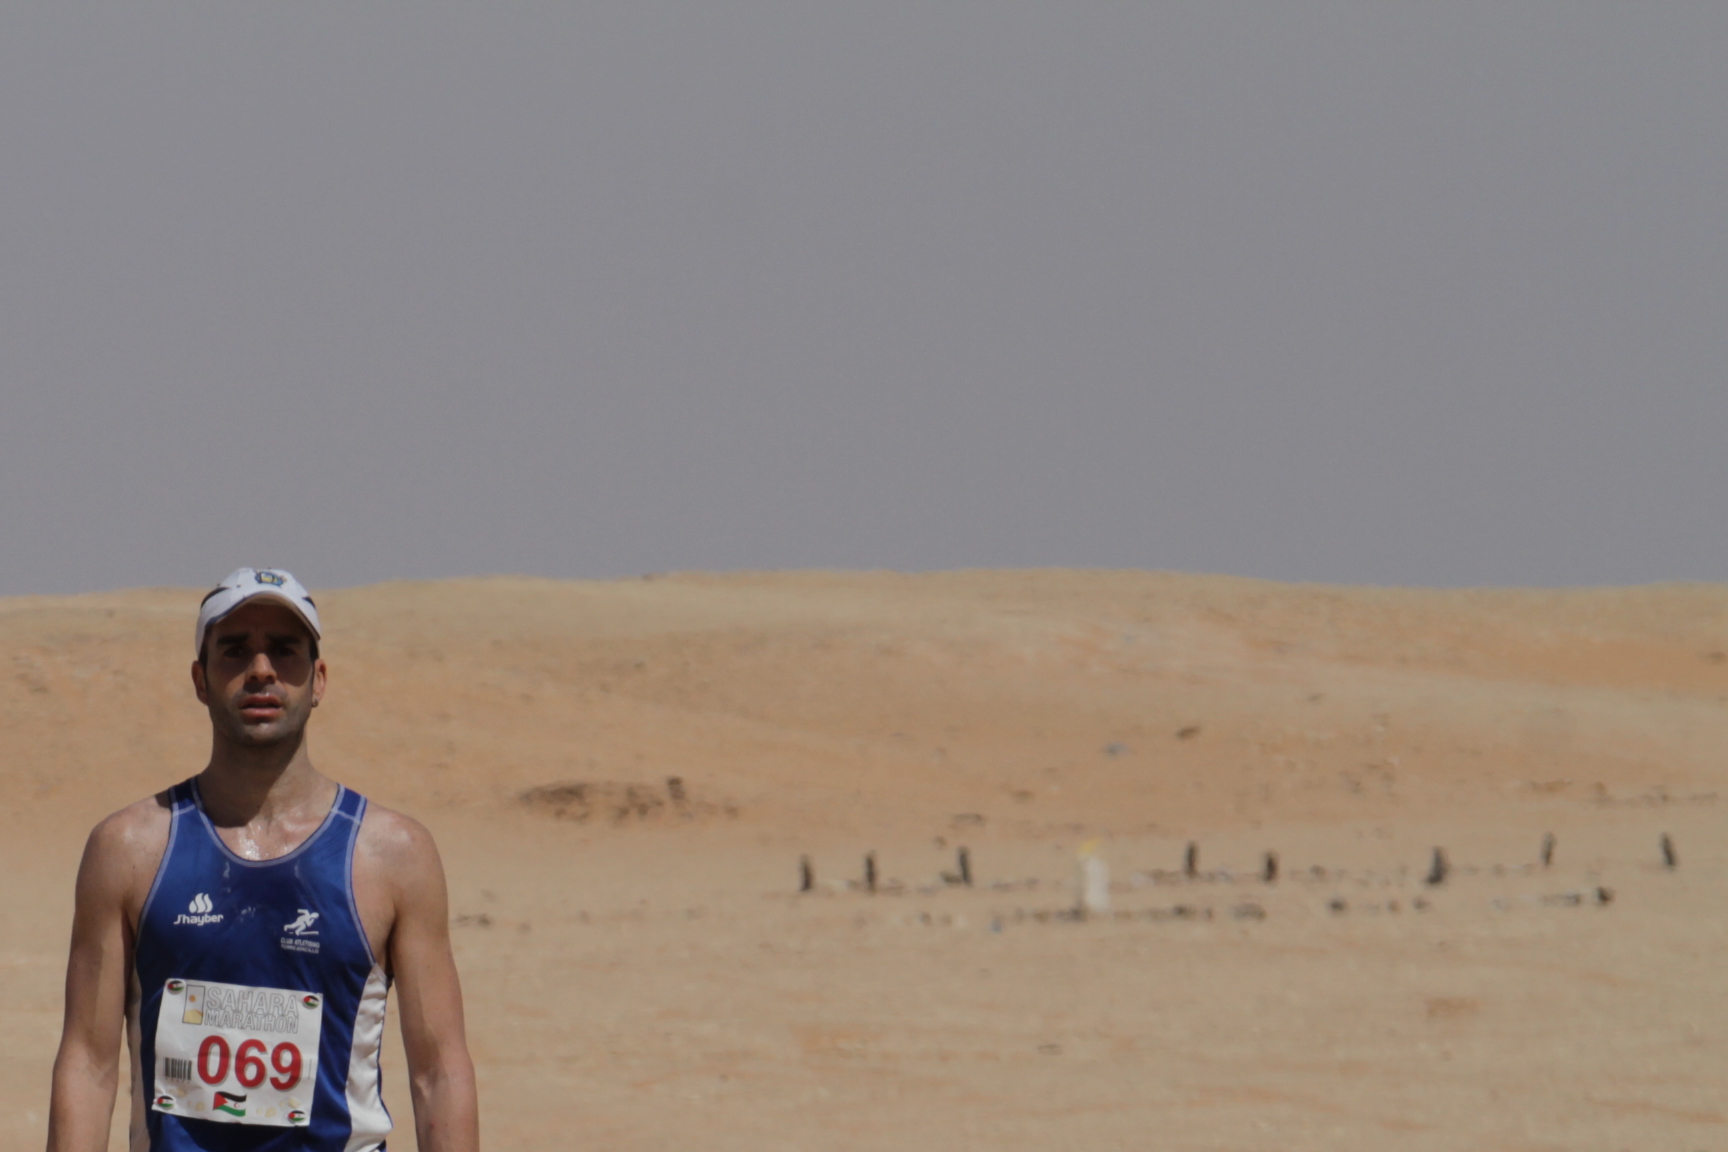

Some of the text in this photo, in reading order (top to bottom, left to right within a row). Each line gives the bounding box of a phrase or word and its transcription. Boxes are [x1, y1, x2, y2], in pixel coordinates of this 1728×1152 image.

[206, 987, 299, 1017] SAHARA
[204, 1009, 299, 1034] MARATHON
[197, 1035, 303, 1091] 069
